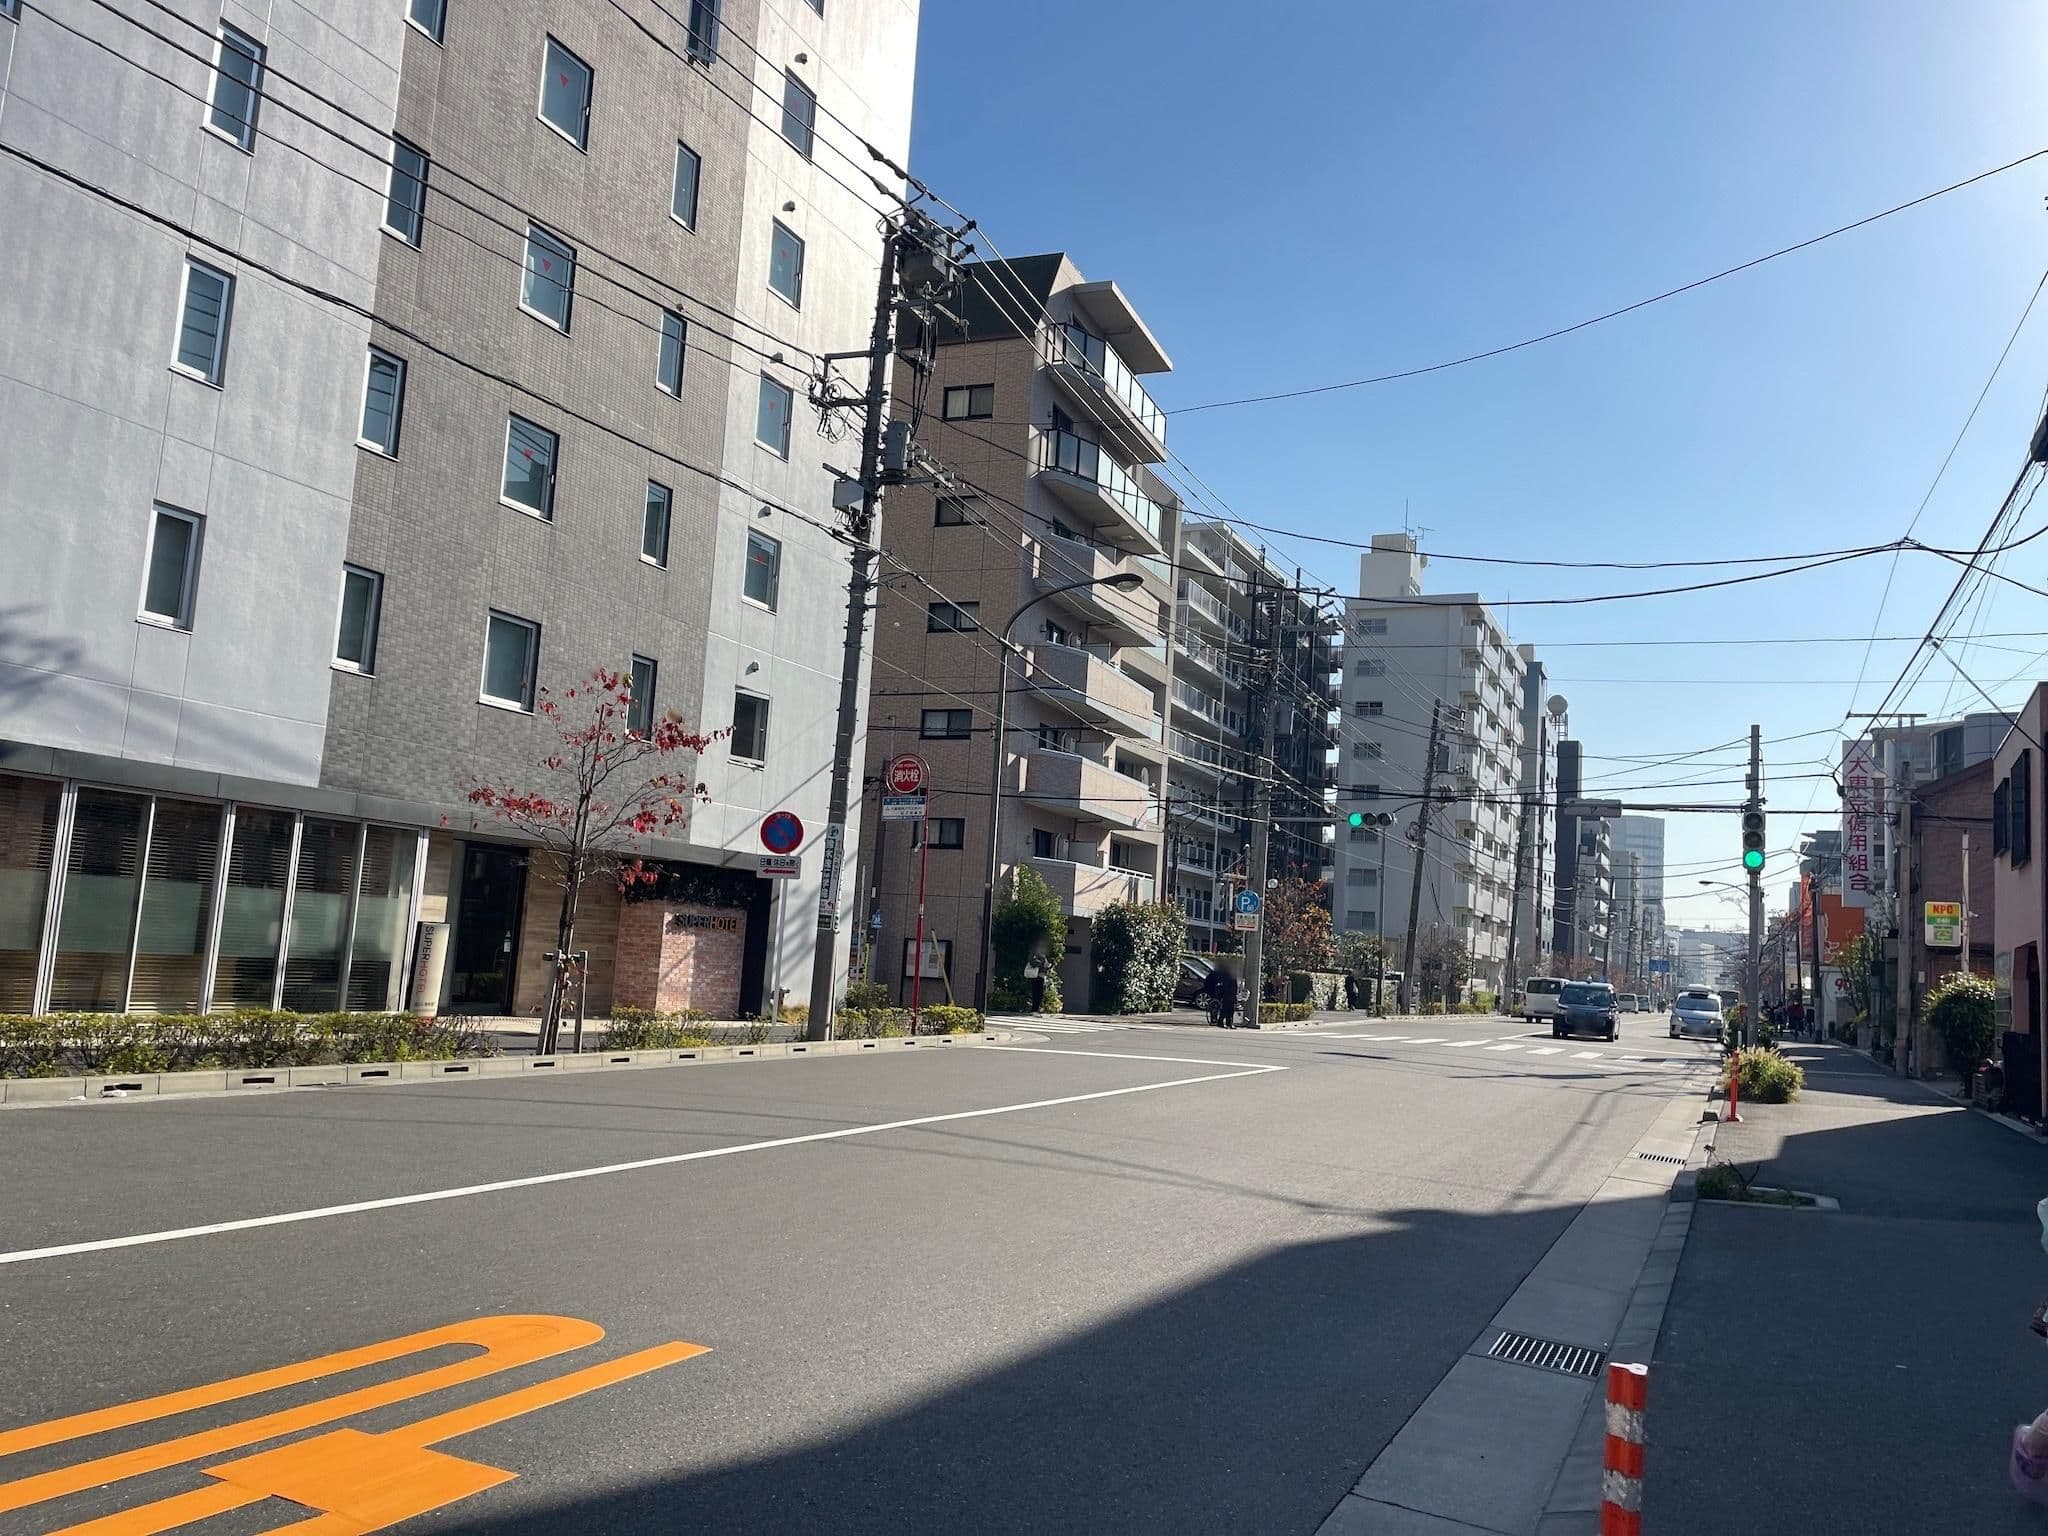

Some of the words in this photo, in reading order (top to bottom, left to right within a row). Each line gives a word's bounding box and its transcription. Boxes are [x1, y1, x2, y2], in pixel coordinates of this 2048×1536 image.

[893, 768, 920, 783] 消火栓
[1846, 756, 1870, 891] 大東京信用組合
